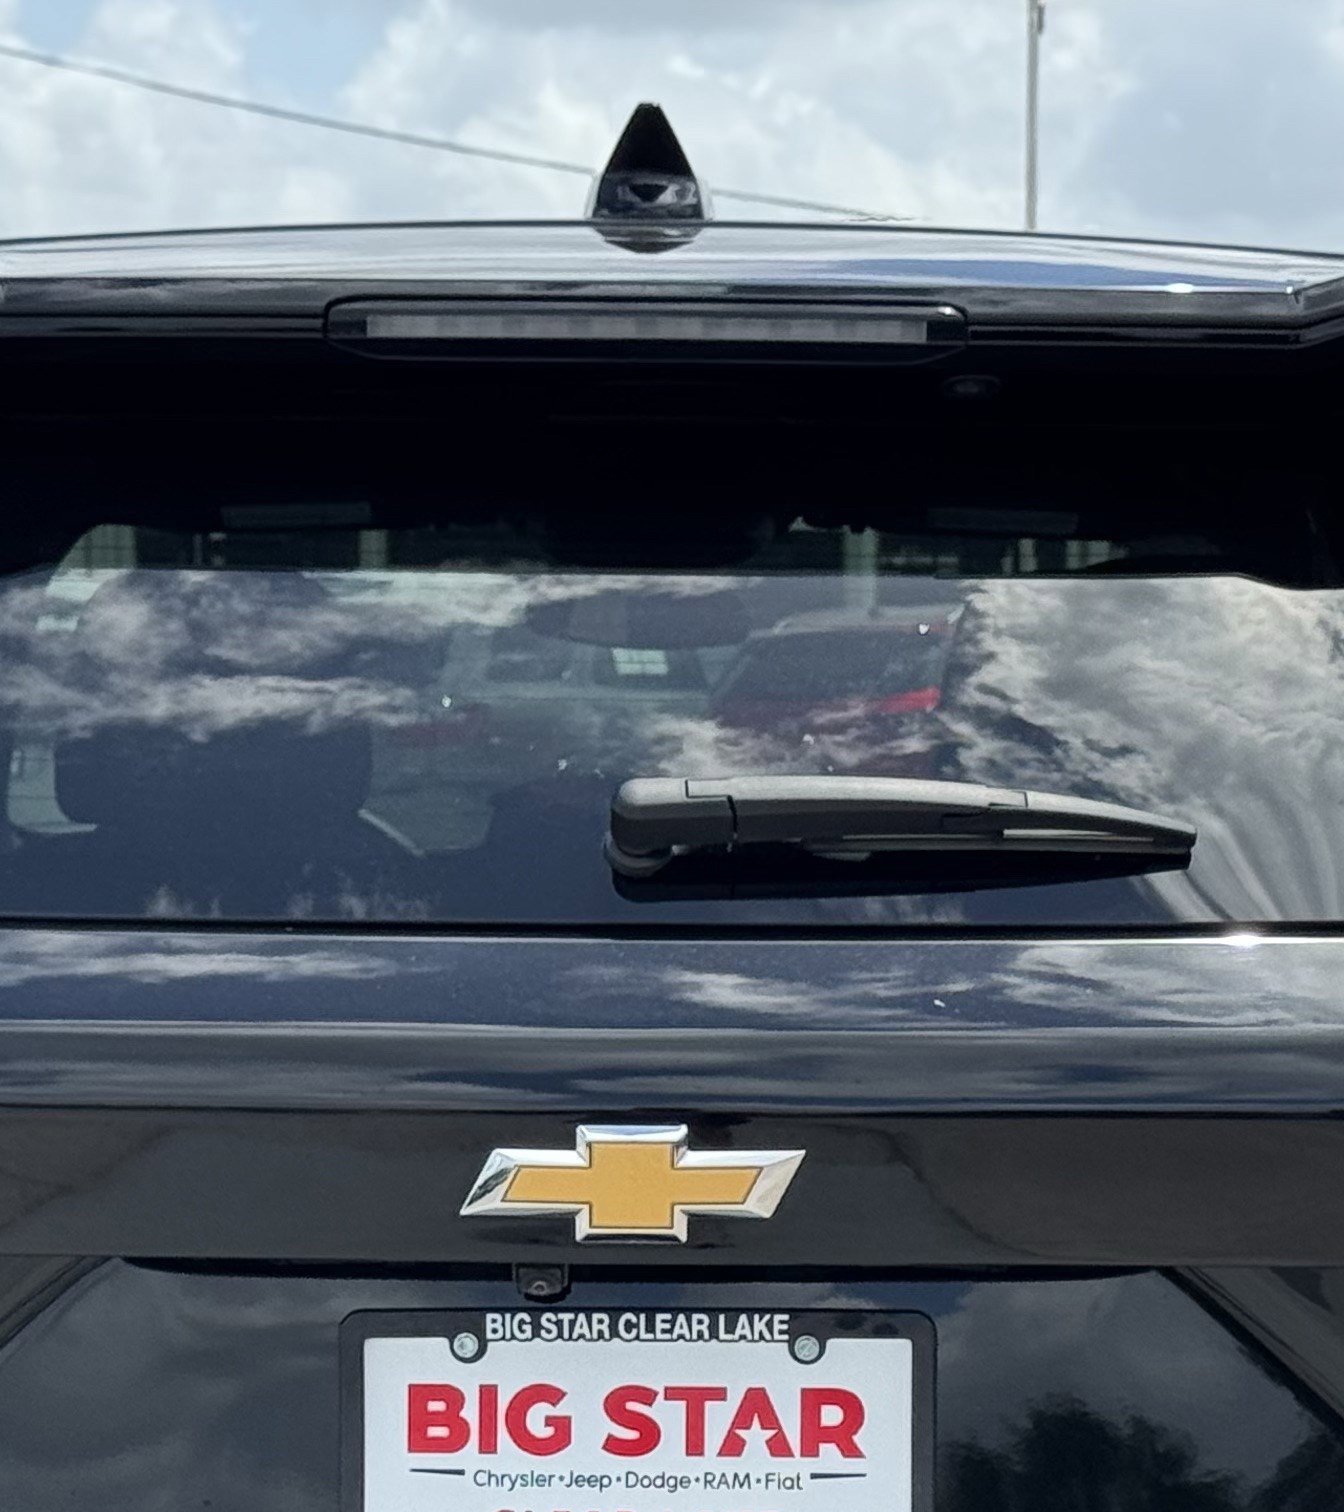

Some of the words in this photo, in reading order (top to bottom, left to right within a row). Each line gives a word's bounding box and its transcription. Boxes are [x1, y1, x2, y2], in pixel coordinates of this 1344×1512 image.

[485, 1313, 532, 1341] BIG
[540, 1313, 611, 1342] STAR
[618, 1313, 710, 1342] CLEAR
[718, 1313, 790, 1342] LAKE
[407, 1383, 573, 1456] BIG
[601, 1384, 867, 1459] STAR
